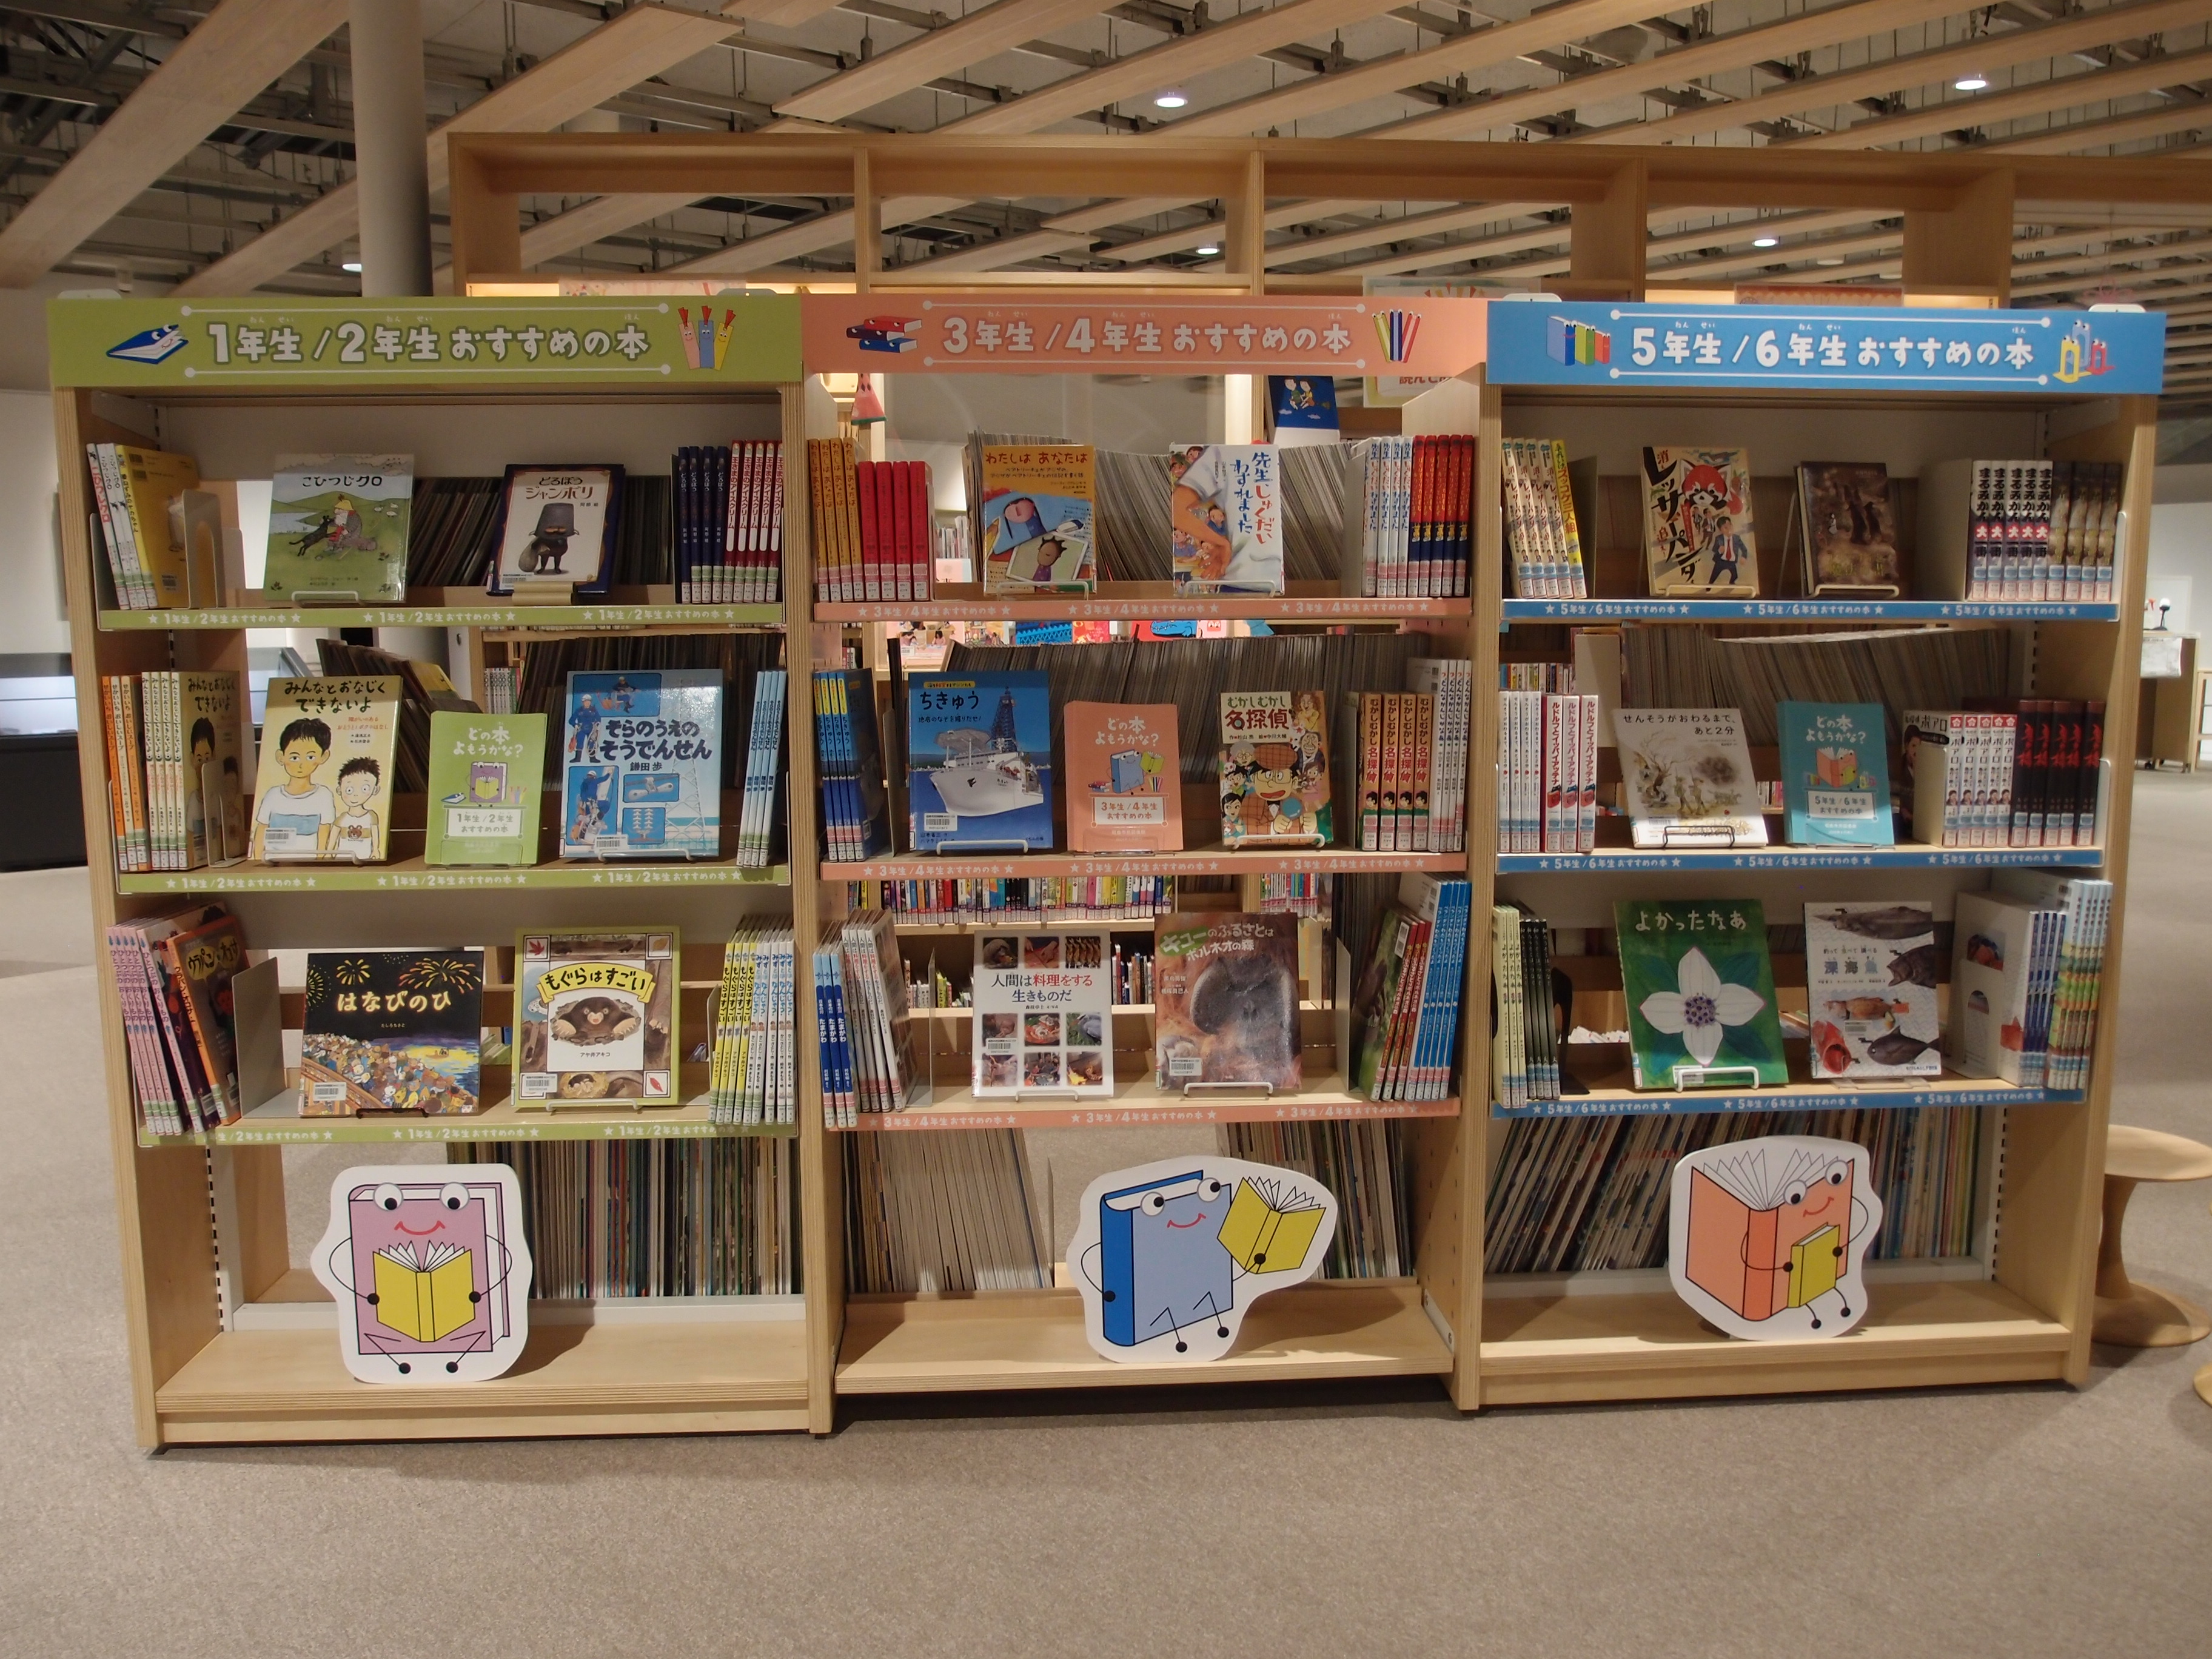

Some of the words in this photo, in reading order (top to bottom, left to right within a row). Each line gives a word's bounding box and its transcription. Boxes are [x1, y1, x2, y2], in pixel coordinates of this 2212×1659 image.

[986, 452, 1031, 464] わたしは
[1038, 451, 1088, 465] あなたは
[302, 475, 383, 488] こひつじクロ
[538, 477, 583, 486] どろぼう
[525, 486, 594, 500] ジャンボリ
[728, 457, 739, 529] 王さまのアイスクリーム
[740, 457, 752, 529] 王さまのアイスクリーム
[751, 457, 763, 529] 王さまのアイスクリーム
[762, 457, 774, 529] 王さまのアイスクリーム
[1230, 459, 1253, 534] わすれました
[284, 680, 385, 695] みんなとおなじく
[296, 696, 372, 714] できないよ
[919, 691, 979, 711] ちきゅう
[1227, 695, 1286, 709] むかしむかし
[606, 719, 700, 739] そらのうえの
[1107, 716, 1147, 734] どの本
[1225, 708, 1290, 731] 名探偵
[1624, 714, 1735, 723] せんそうがおわるまで、
[1817, 714, 1853, 732] どの本
[468, 725, 511, 745] どの本
[1095, 731, 1159, 746] よもうかな?
[1695, 726, 1734, 736] あと2分
[453, 741, 524, 757] よもうかな?
[600, 739, 713, 761] そうでんせん
[1552, 702, 1560, 785] ルドルフとイッパイアッテナ
[1567, 702, 1576, 785] ルドルフとイッパイアッテナ
[1585, 701, 1595, 785] ルドルフとイッパイアッテナ
[629, 762, 650, 771] 鎌田
[652, 762, 663, 771] 歩
[1635, 910, 1747, 931] よかったなあ
[1160, 923, 1274, 953] キューのふるさとは
[1185, 939, 1255, 961] ボルネオの森
[544, 967, 646, 991] もぐらはすごい
[991, 974, 1093, 988] 人間は料理をする
[337, 990, 452, 1012] はなびのひ
[719, 967, 729, 1022] もぐらはすごい
[727, 966, 738, 1022] もぐらはすごい
[736, 966, 746, 1022] もぐらはすごい
[744, 966, 754, 1022] もぐらはすごい
[1012, 989, 1072, 1002] 生きものだ
[838, 1017, 846, 1043] たまがわ
